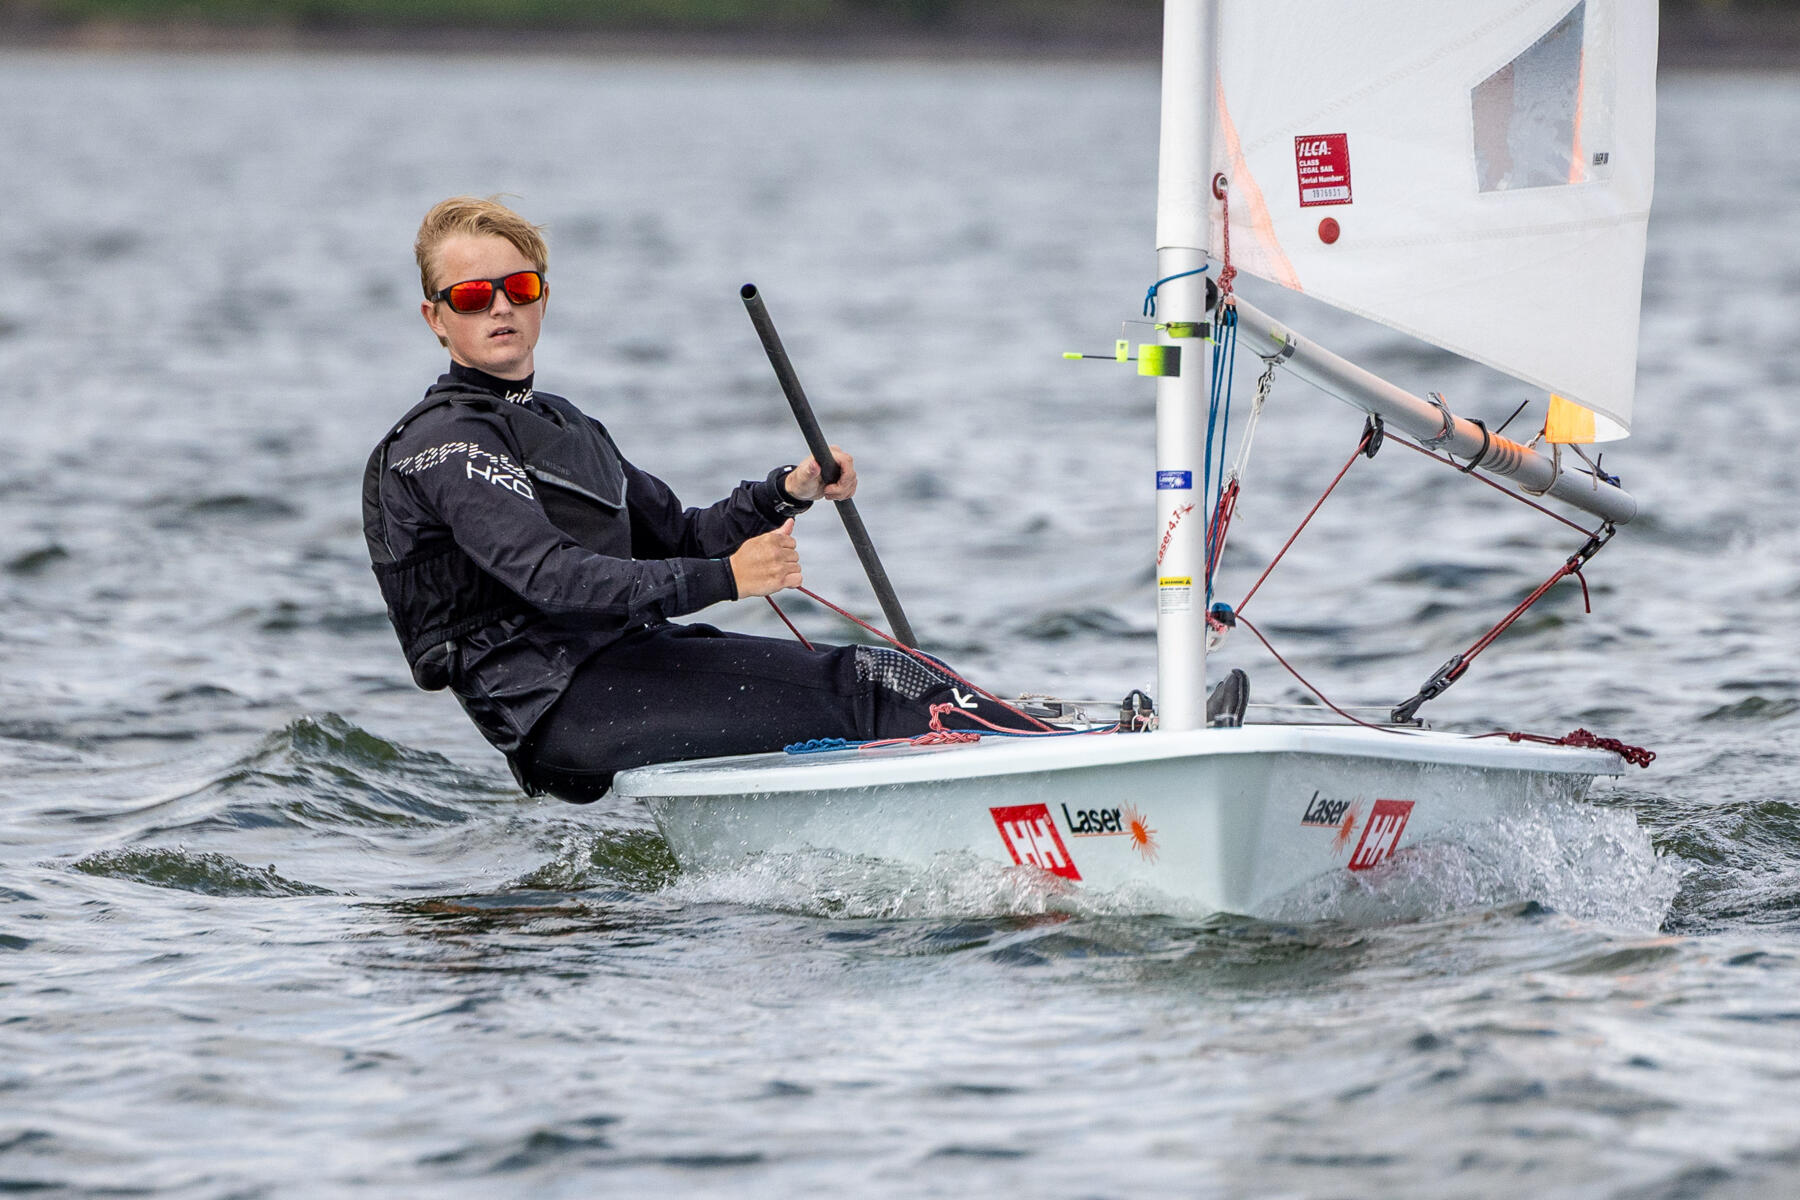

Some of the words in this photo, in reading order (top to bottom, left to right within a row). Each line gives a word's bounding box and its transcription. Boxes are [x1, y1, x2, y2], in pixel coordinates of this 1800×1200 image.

[1299, 159, 1319, 167] CLASS
[1320, 165, 1334, 173] SAIL
[1302, 790, 1350, 825] Laser
[1061, 803, 1122, 833] Laser
